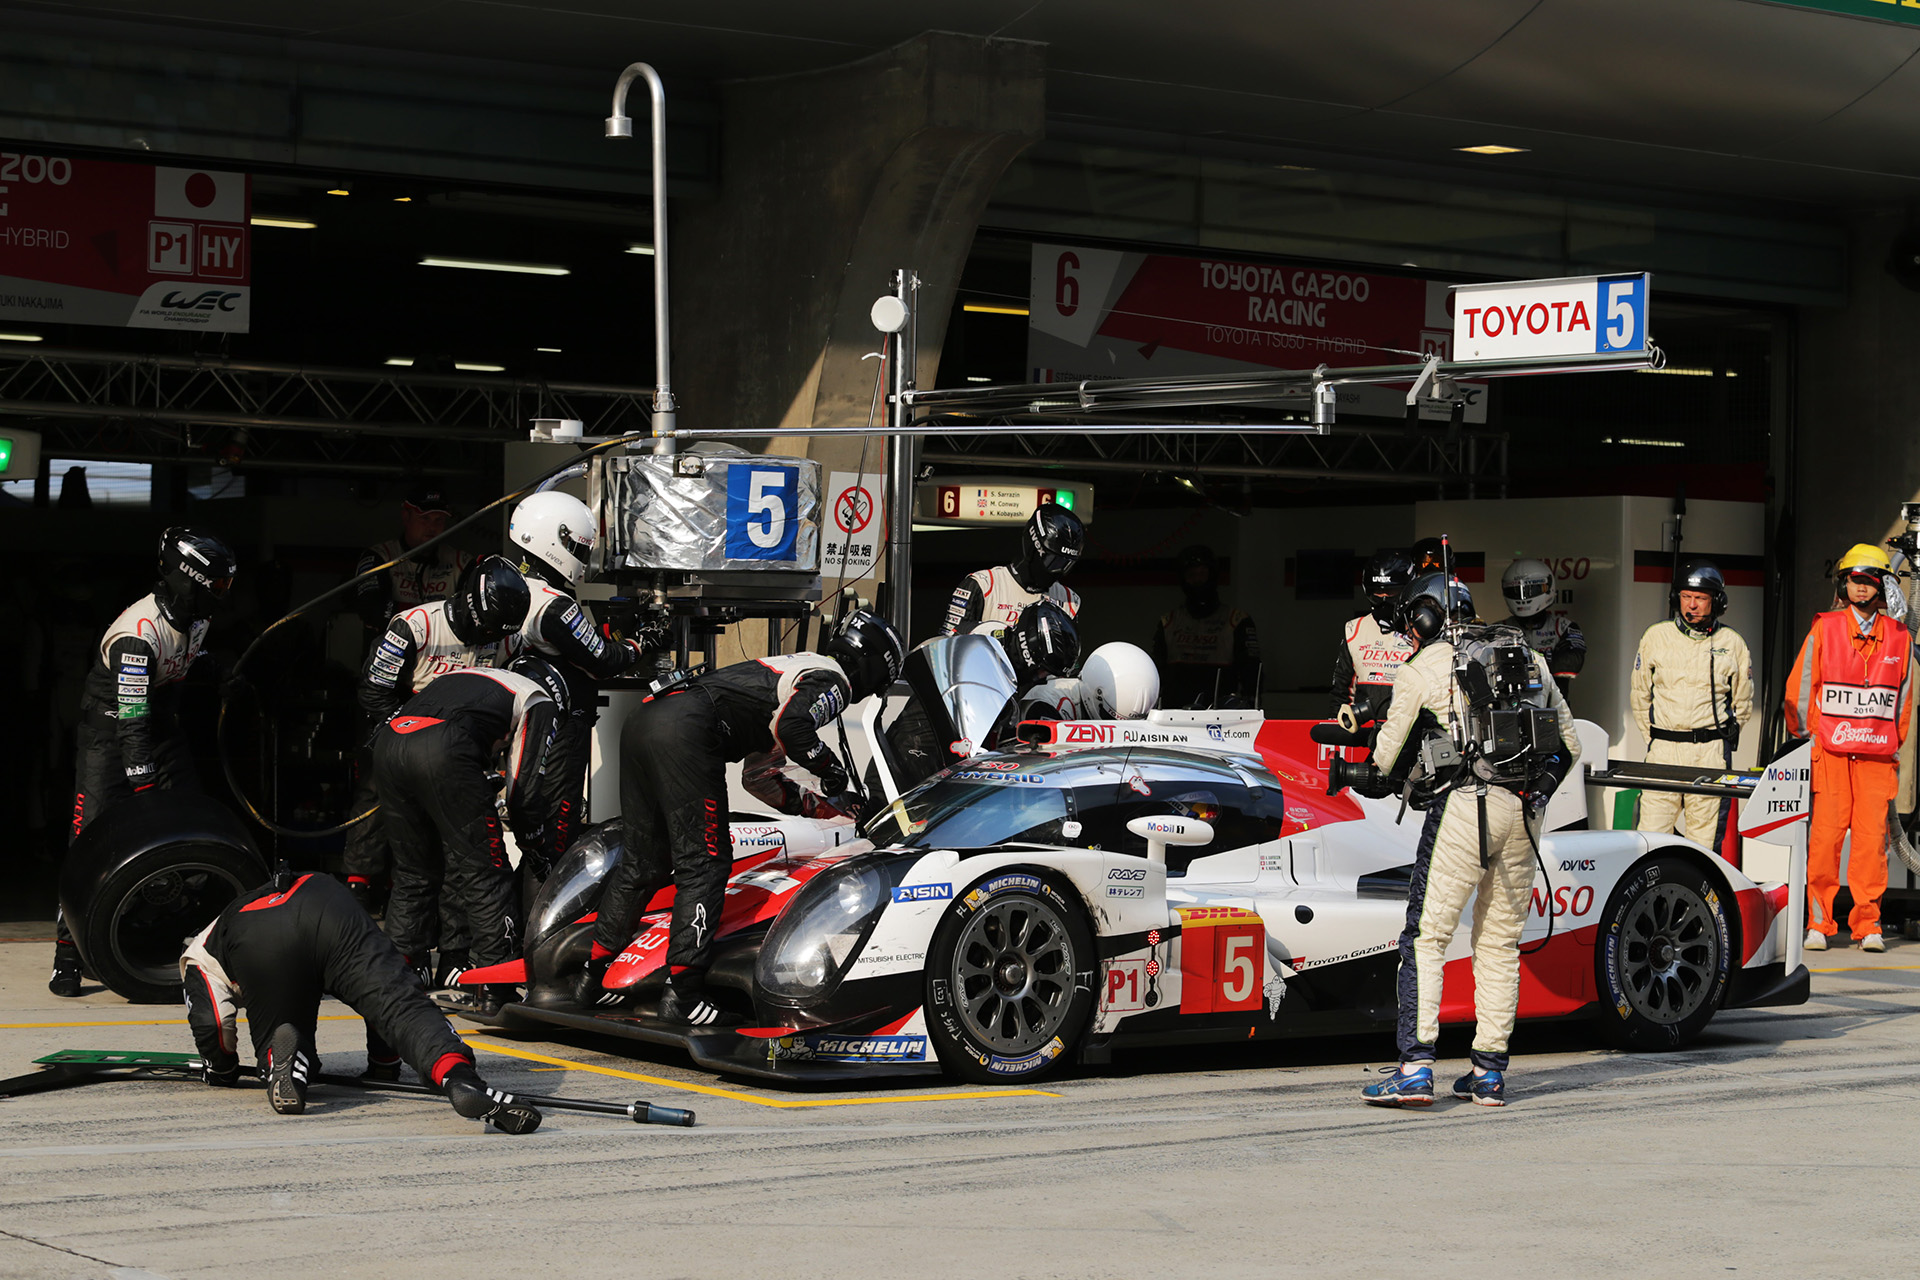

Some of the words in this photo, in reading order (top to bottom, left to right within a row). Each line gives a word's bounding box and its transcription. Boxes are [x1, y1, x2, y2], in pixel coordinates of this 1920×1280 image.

[154, 231, 187, 265] P1
[202, 234, 241, 268] HY
[1056, 251, 1080, 317] 6
[1200, 262, 1286, 300] TOYOTA
[1292, 271, 1370, 304] GAZOO
[18, 296, 64, 309] NAKAJIMA
[161, 290, 241, 311] WEC
[1248, 295, 1327, 328] RACING
[1463, 301, 1592, 339] TOYOTA
[1606, 283, 1635, 349] 5
[1205, 326, 1262, 346] TOYOTA
[1316, 335, 1367, 355] HYBRID
[747, 471, 785, 548] 5
[943, 490, 960, 514] 6
[1029, 525, 1047, 557] uvex
[545, 551, 564, 566] uvex
[825, 557, 836, 565] NO
[837, 558, 871, 566] SOKING
[178, 561, 213, 589] uvex
[466, 593, 482, 627] uvex
[564, 605, 578, 621] JTEKT
[387, 632, 406, 647] JTEKT
[1017, 631, 1036, 668] uvex
[545, 675, 565, 711] uvex
[1826, 689, 1853, 704] PIT
[1858, 692, 1895, 708] LANE
[1065, 723, 1117, 743] ZENT
[1140, 732, 1170, 743] AISIN
[1172, 733, 1189, 743] AW
[1223, 728, 1251, 740] zf.com
[1831, 721, 1852, 745] 6
[1845, 733, 1888, 744] SHANGHAI
[951, 771, 1045, 785] HYBRID
[1767, 768, 1798, 781] Mobil
[1800, 768, 1809, 781] 1
[1767, 800, 1801, 815] JTEKT
[525, 824, 545, 840] Mobil
[554, 799, 572, 853] DENSO
[704, 798, 720, 857] DENSO
[1147, 822, 1175, 833] Mobil
[1176, 825, 1185, 834] 1
[485, 816, 503, 868] DENSO
[740, 836, 785, 846] HYBRID
[988, 876, 1040, 893] MICHELIN
[1108, 869, 1147, 881] RAYS
[898, 885, 949, 900] AISIN
[1527, 886, 1594, 918] NSO
[1186, 908, 1248, 920] DHL
[1717, 913, 1731, 971] MICHELIN
[857, 956, 894, 964] MITSUBISHI
[896, 953, 925, 961] ELECTRIC
[1306, 954, 1348, 967] TOYOTA
[1350, 944, 1387, 958] GAZOO
[1607, 937, 1620, 994] MICHELIN
[1223, 935, 1255, 1003] 5
[1107, 968, 1138, 1004] P1
[816, 1039, 925, 1054] MICHELIN
[991, 1056, 1043, 1073] MICHELIN
